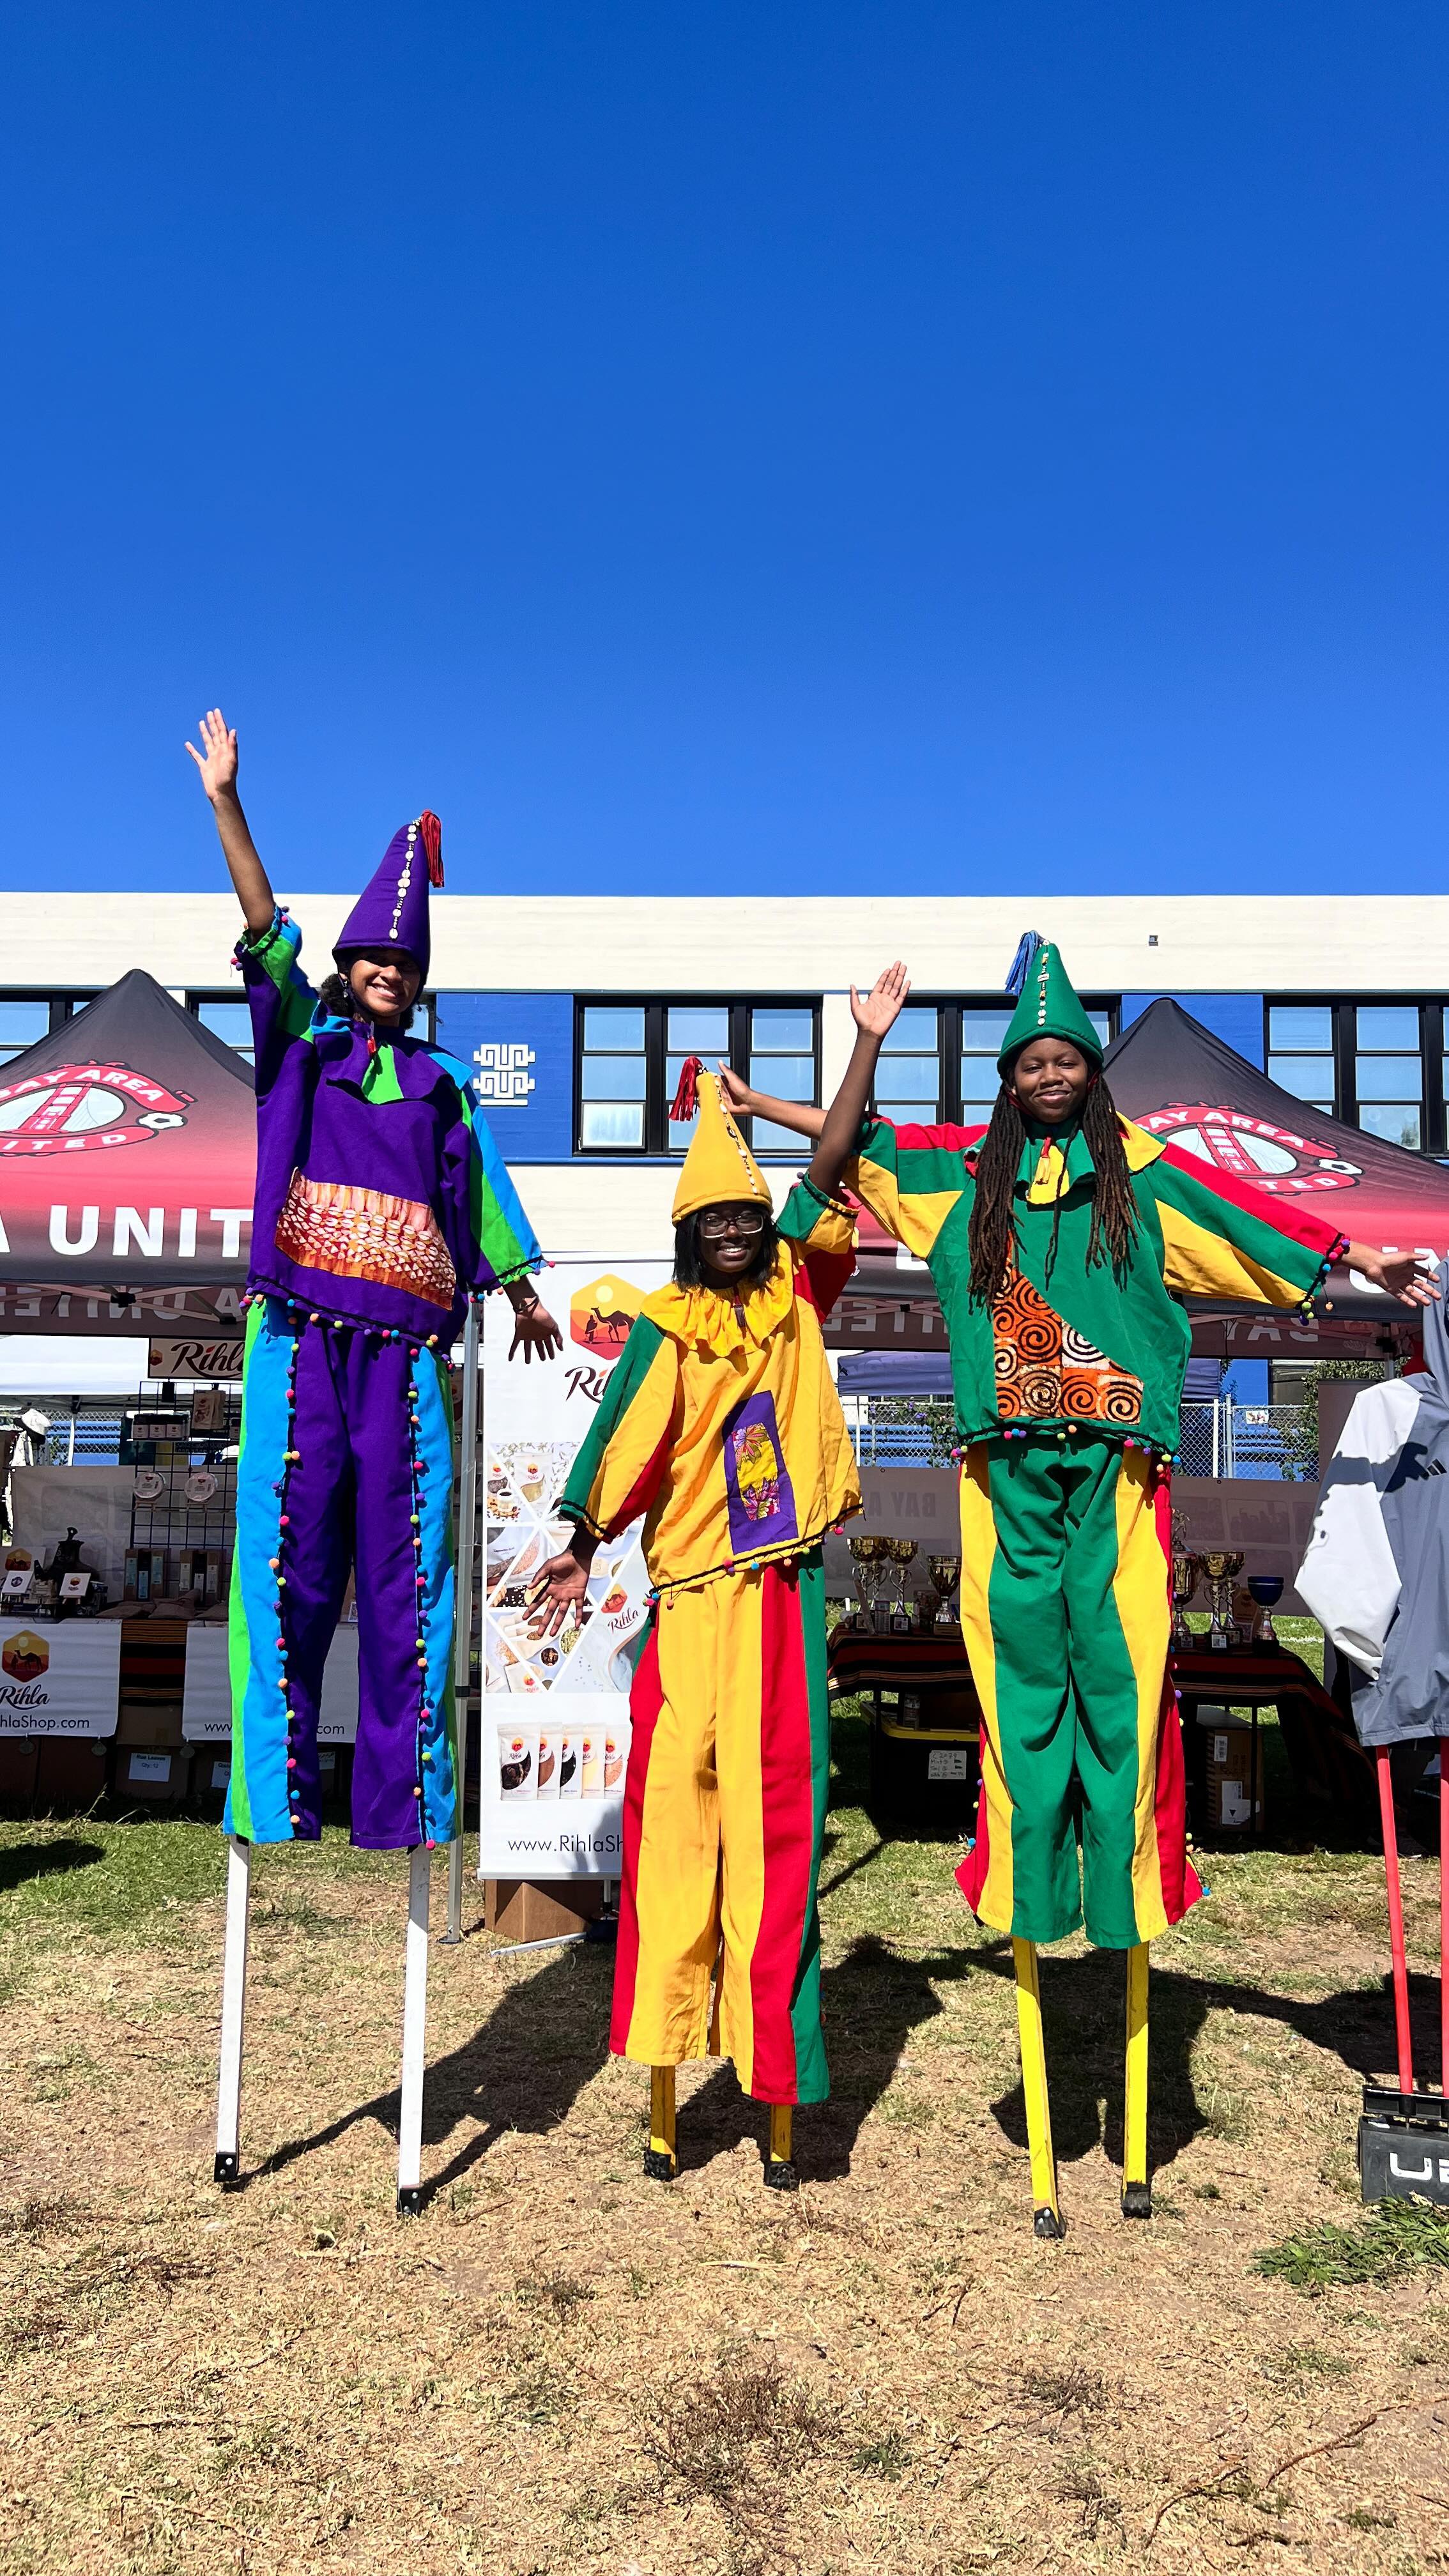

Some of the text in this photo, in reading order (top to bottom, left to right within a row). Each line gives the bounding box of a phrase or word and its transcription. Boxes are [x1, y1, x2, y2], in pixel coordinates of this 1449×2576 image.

[74, 1069, 164, 1102] AREA
[1203, 1112, 1305, 1148] AREA
[49, 1204, 254, 1258] UNIT
[0, 1684, 50, 1710] Rihla
